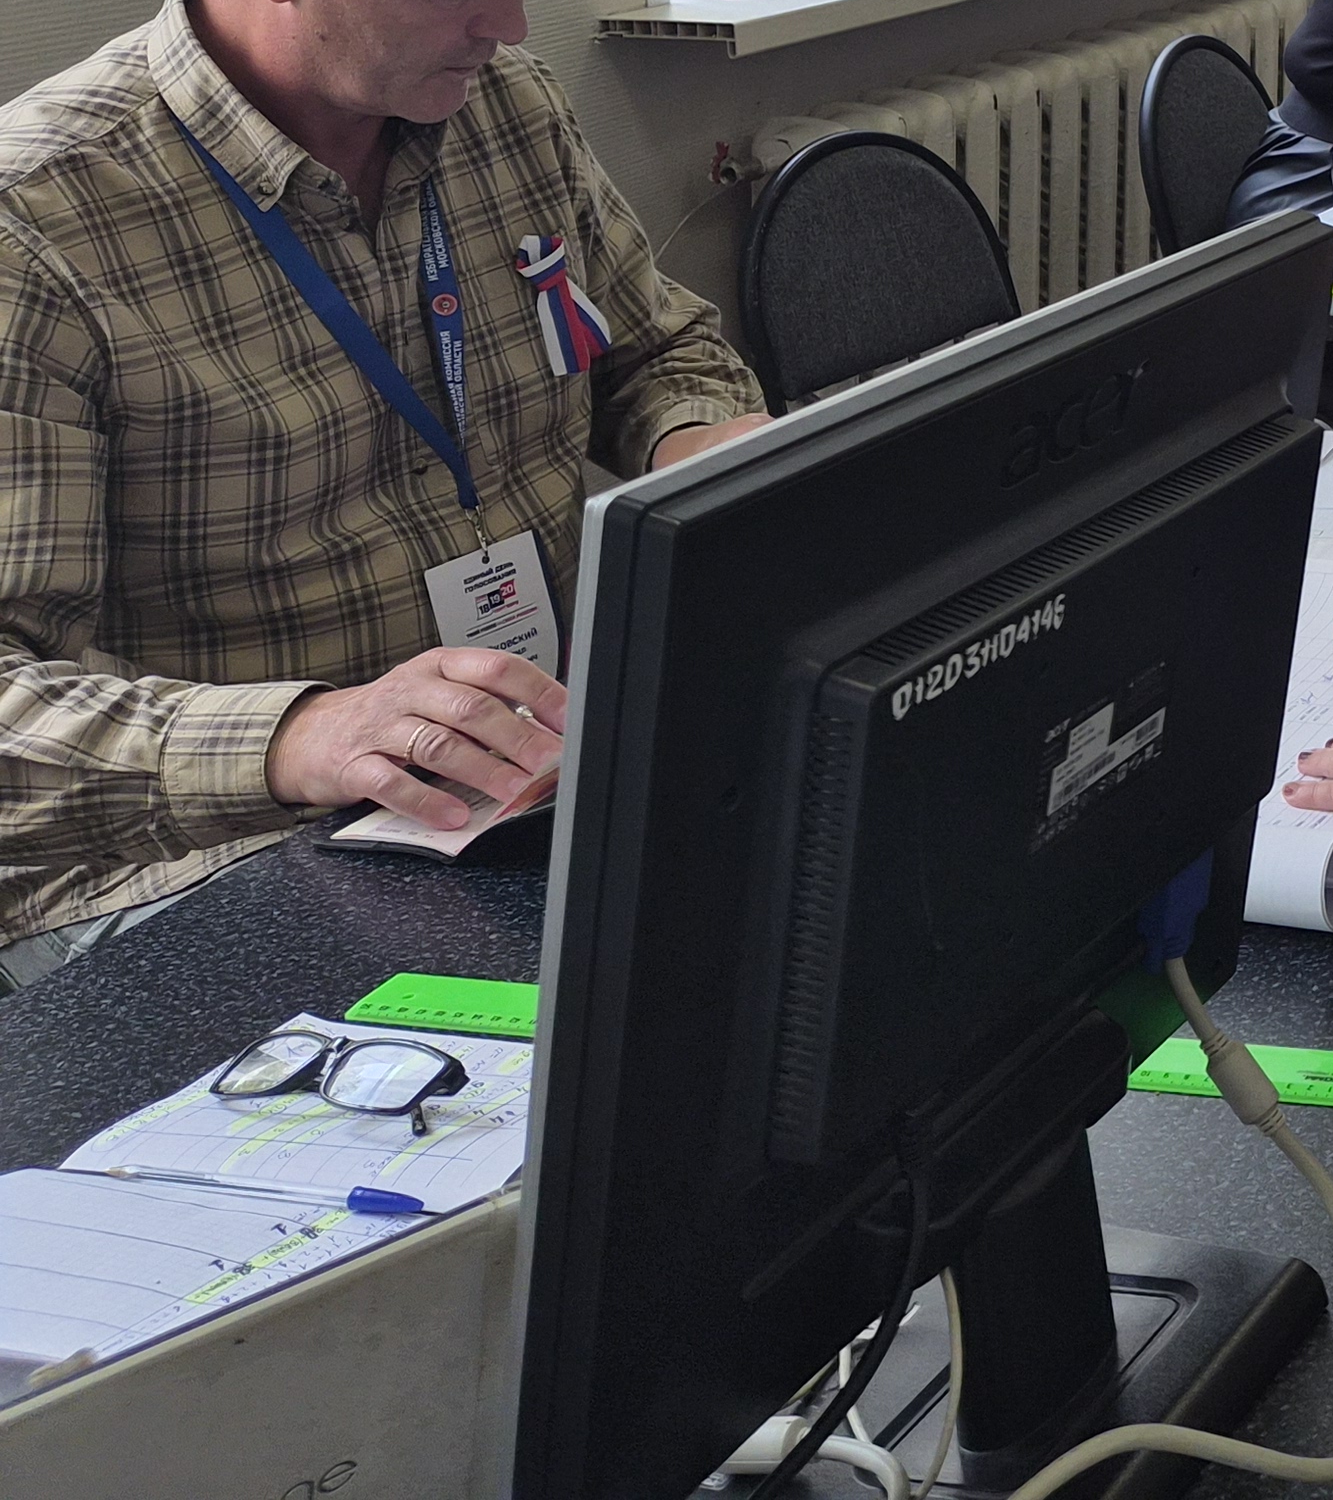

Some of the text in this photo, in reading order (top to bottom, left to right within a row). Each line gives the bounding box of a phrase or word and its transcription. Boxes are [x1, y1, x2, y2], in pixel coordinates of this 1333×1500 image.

[429, 209, 449, 269] МОСКОВСКОЙ
[439, 330, 453, 381] КОМИССИЯ
[453, 340, 463, 382] ОБЛАСТИ
[464, 568, 517, 594] ГОЛОСОВАНИЯ
[479, 584, 514, 614] 18 19 20
[488, 627, 538, 650] КОВСКИЙ
